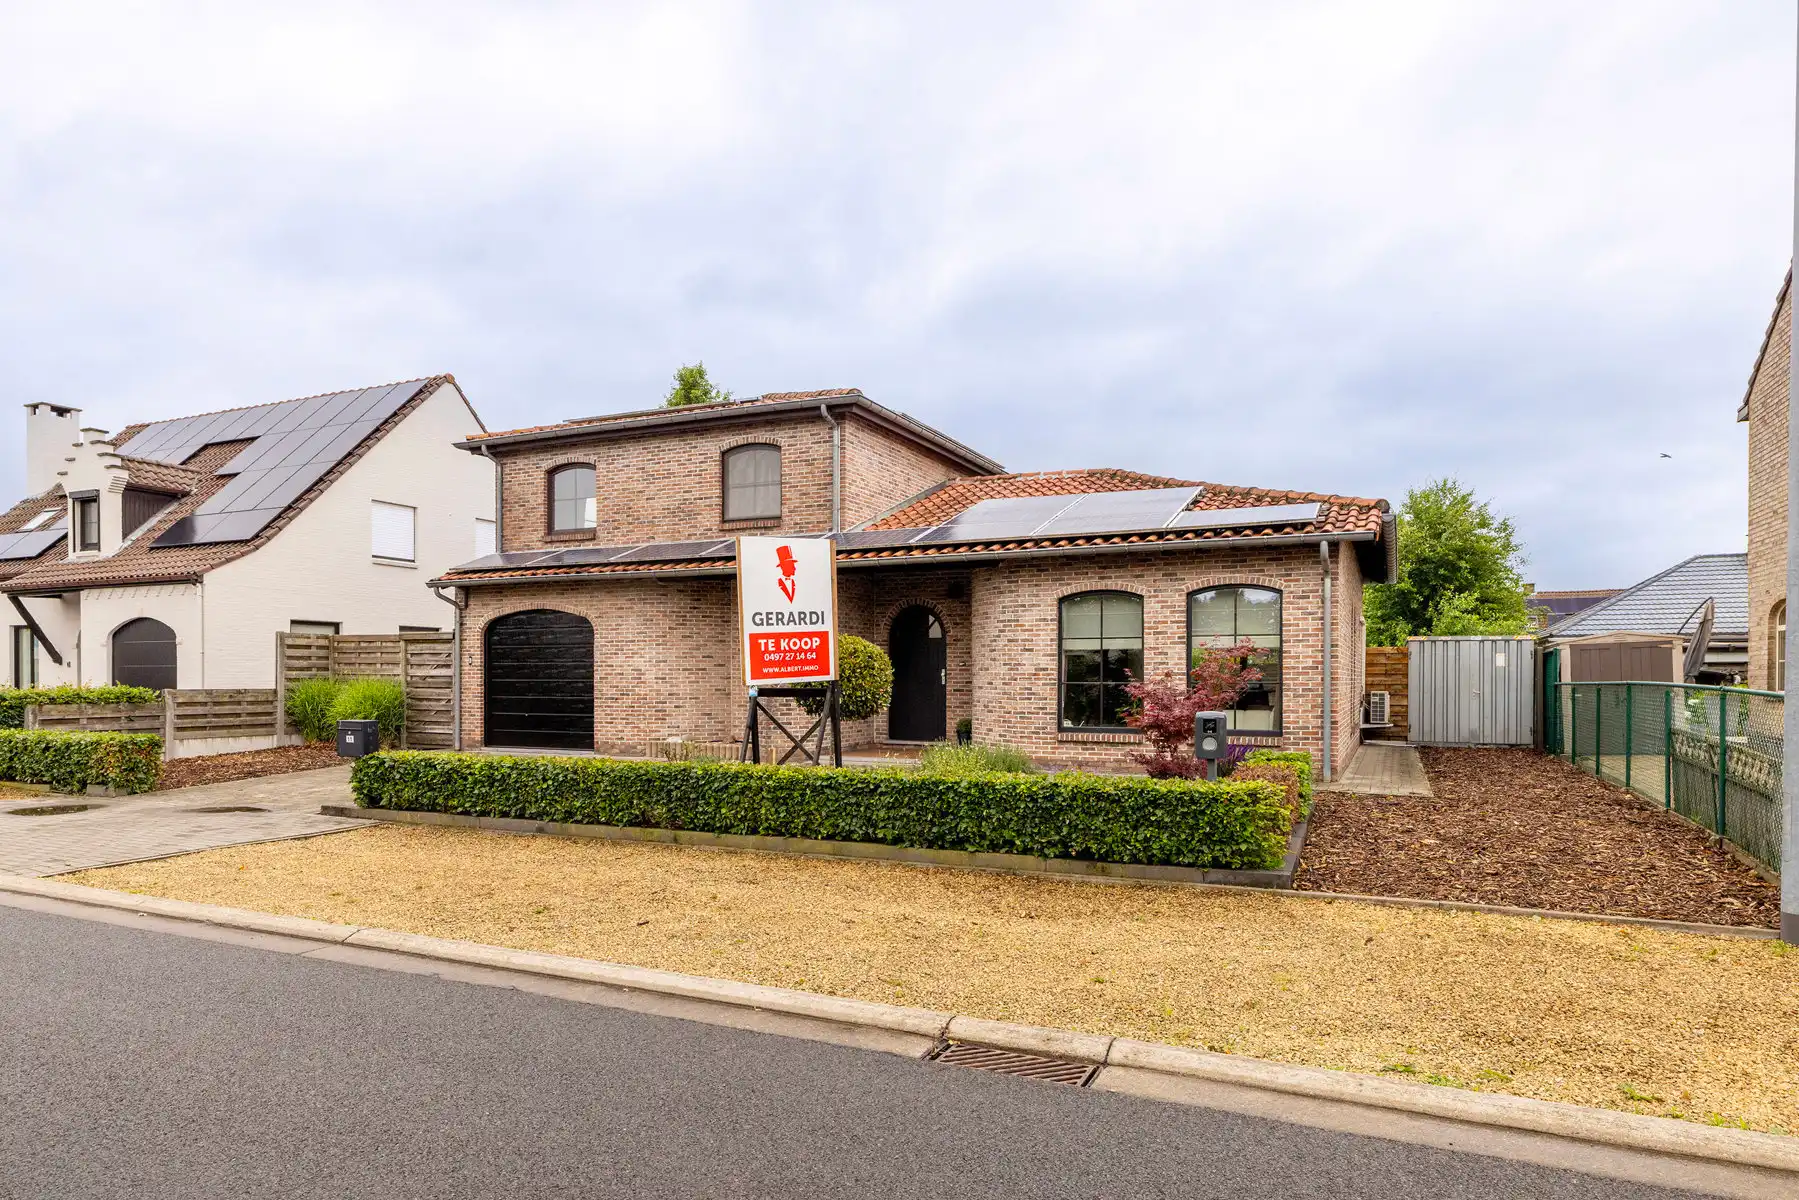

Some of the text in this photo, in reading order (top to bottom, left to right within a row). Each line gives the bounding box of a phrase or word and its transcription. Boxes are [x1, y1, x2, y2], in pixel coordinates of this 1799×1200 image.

[752, 611, 824, 626] GERARDI
[758, 638, 820, 652] TE KOOP
[764, 652, 816, 661] 0497 27 14 64
[762, 665, 818, 673] WWW.ALBERT.IMMO
